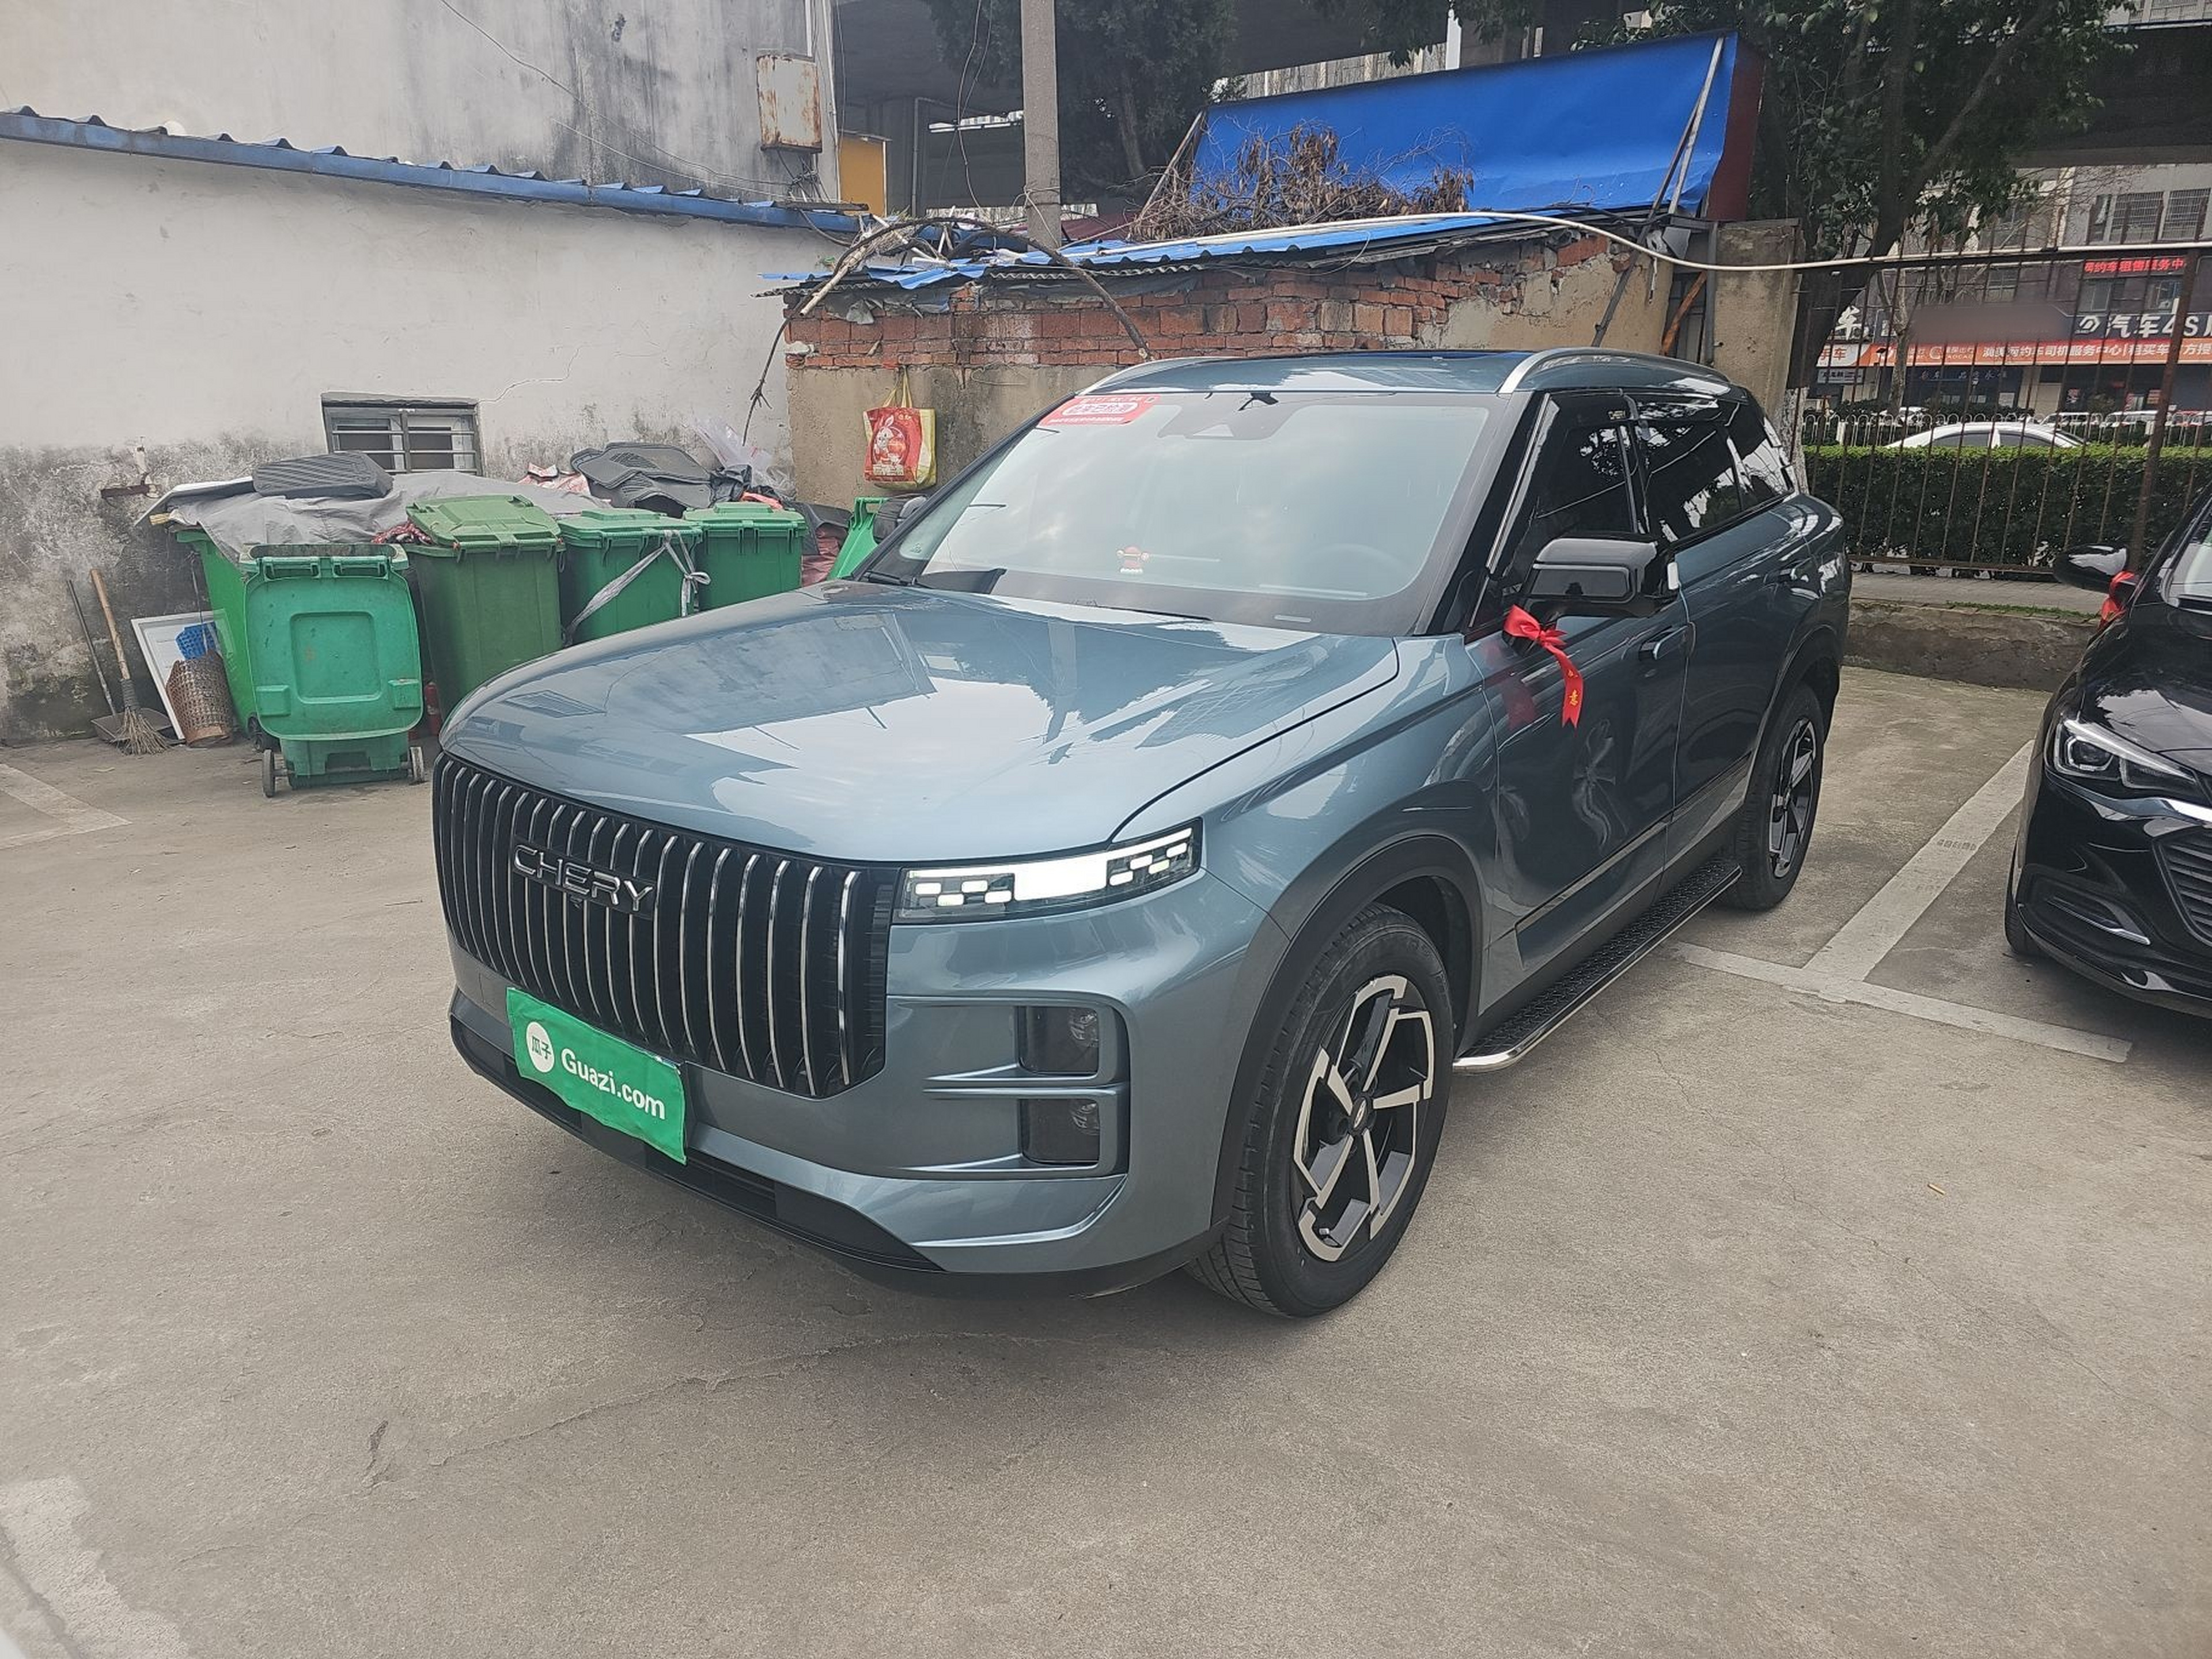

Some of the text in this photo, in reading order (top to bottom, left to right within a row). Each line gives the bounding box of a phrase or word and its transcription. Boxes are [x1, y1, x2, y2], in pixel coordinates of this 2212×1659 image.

[2085, 257, 2187, 272] 网约车租售服务中
[515, 844, 653, 911] CHERY
[532, 1035, 552, 1060] 瓜子
[561, 1048, 665, 1120] Guazi.com
